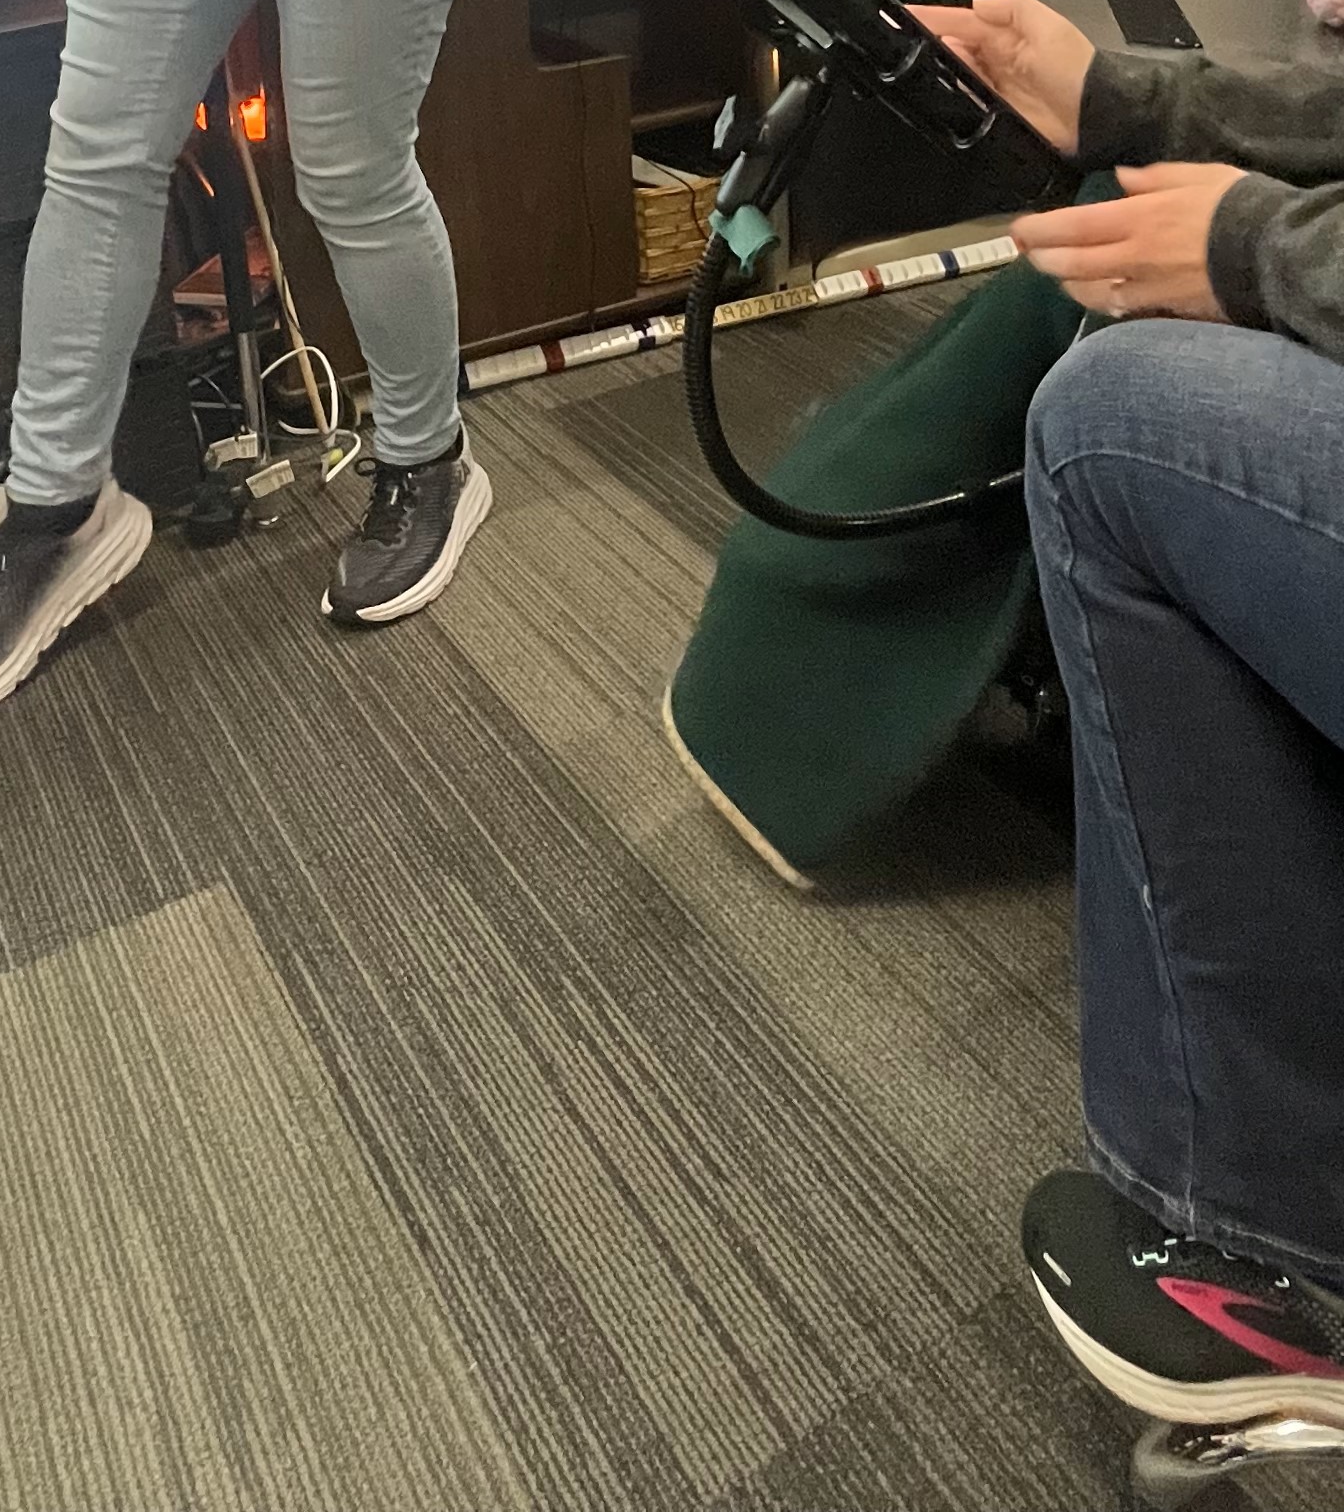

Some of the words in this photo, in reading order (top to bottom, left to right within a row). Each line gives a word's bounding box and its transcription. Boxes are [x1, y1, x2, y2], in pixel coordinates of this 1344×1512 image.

[719, 305, 736, 322] 19
[736, 301, 753, 319] 20
[771, 294, 787, 310] 22
[786, 291, 803, 307] 23
